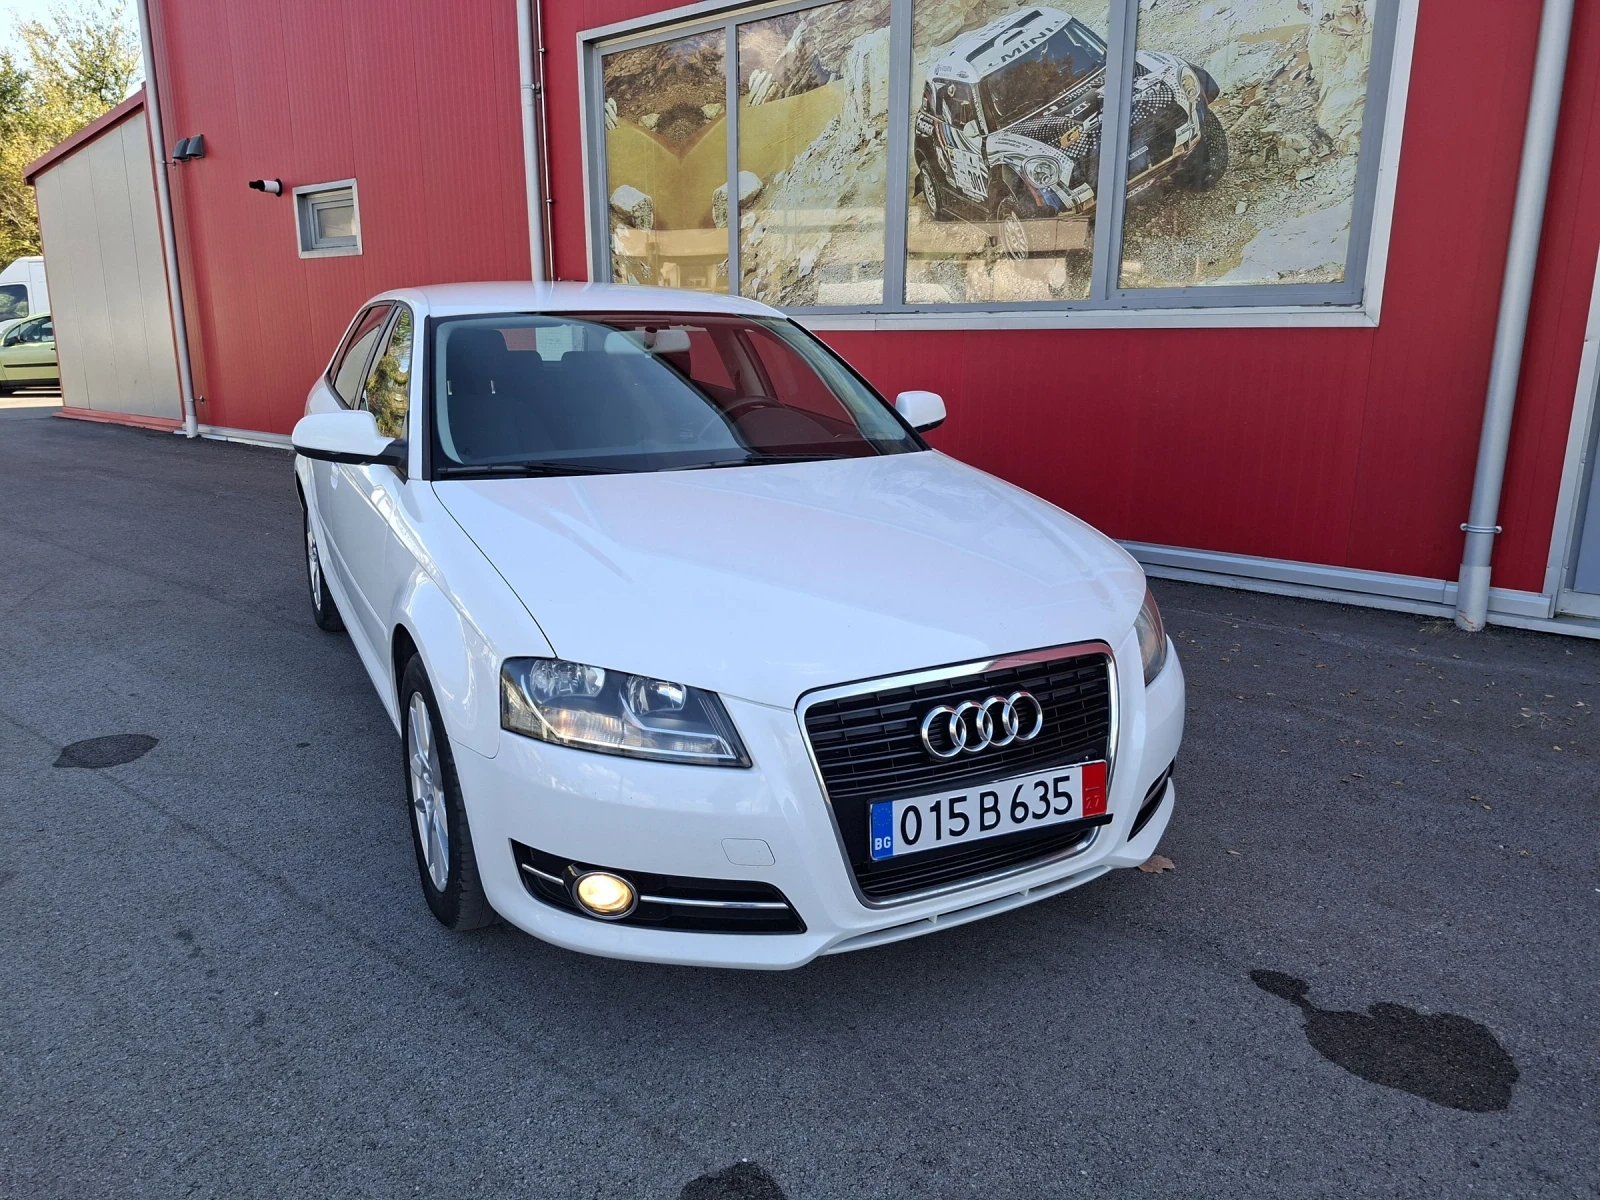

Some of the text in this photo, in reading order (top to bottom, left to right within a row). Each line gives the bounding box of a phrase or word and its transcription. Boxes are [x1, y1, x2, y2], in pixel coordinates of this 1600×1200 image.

[900, 775, 1073, 846] 015 B 635
[874, 836, 892, 850] BG
